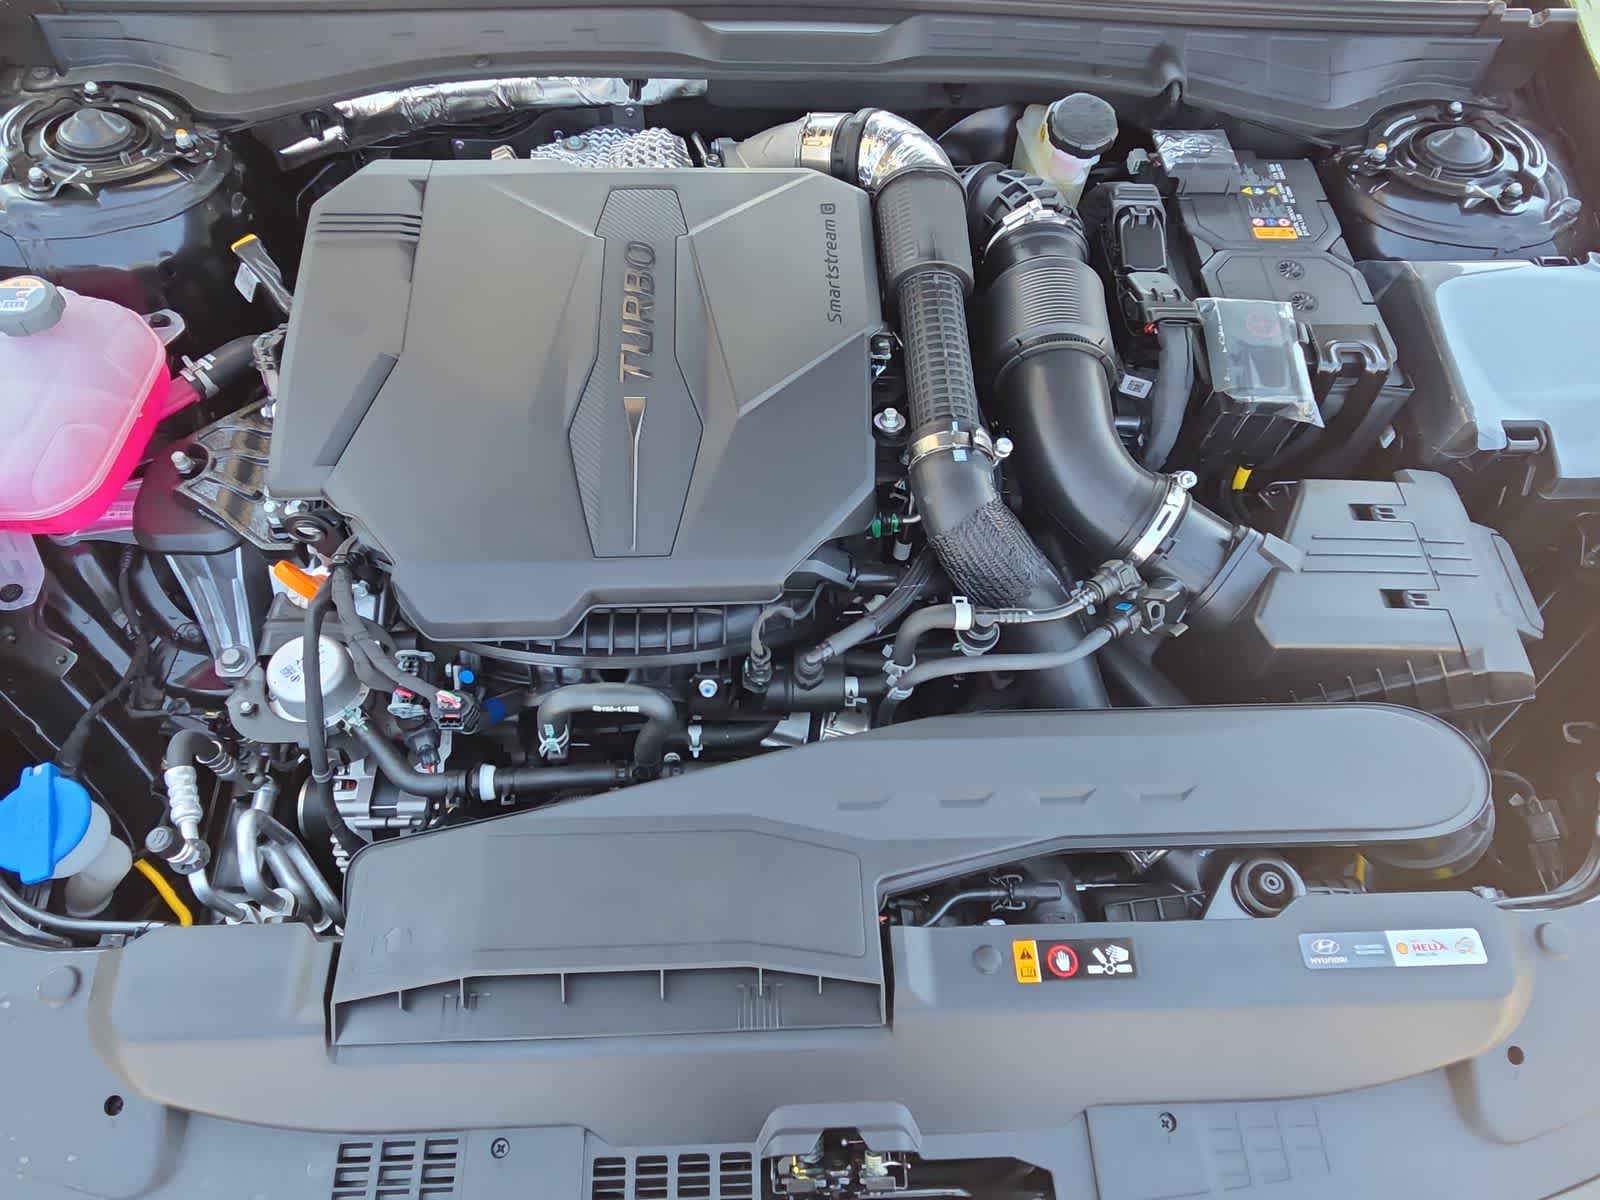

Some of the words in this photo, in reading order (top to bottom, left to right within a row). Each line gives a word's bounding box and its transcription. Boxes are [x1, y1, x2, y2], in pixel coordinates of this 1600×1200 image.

[824, 218, 842, 324] Smartstream
[618, 240, 656, 384] TURBO
[1310, 956, 1348, 965] HYUNDAI
[1411, 942, 1448, 952] HELIX
